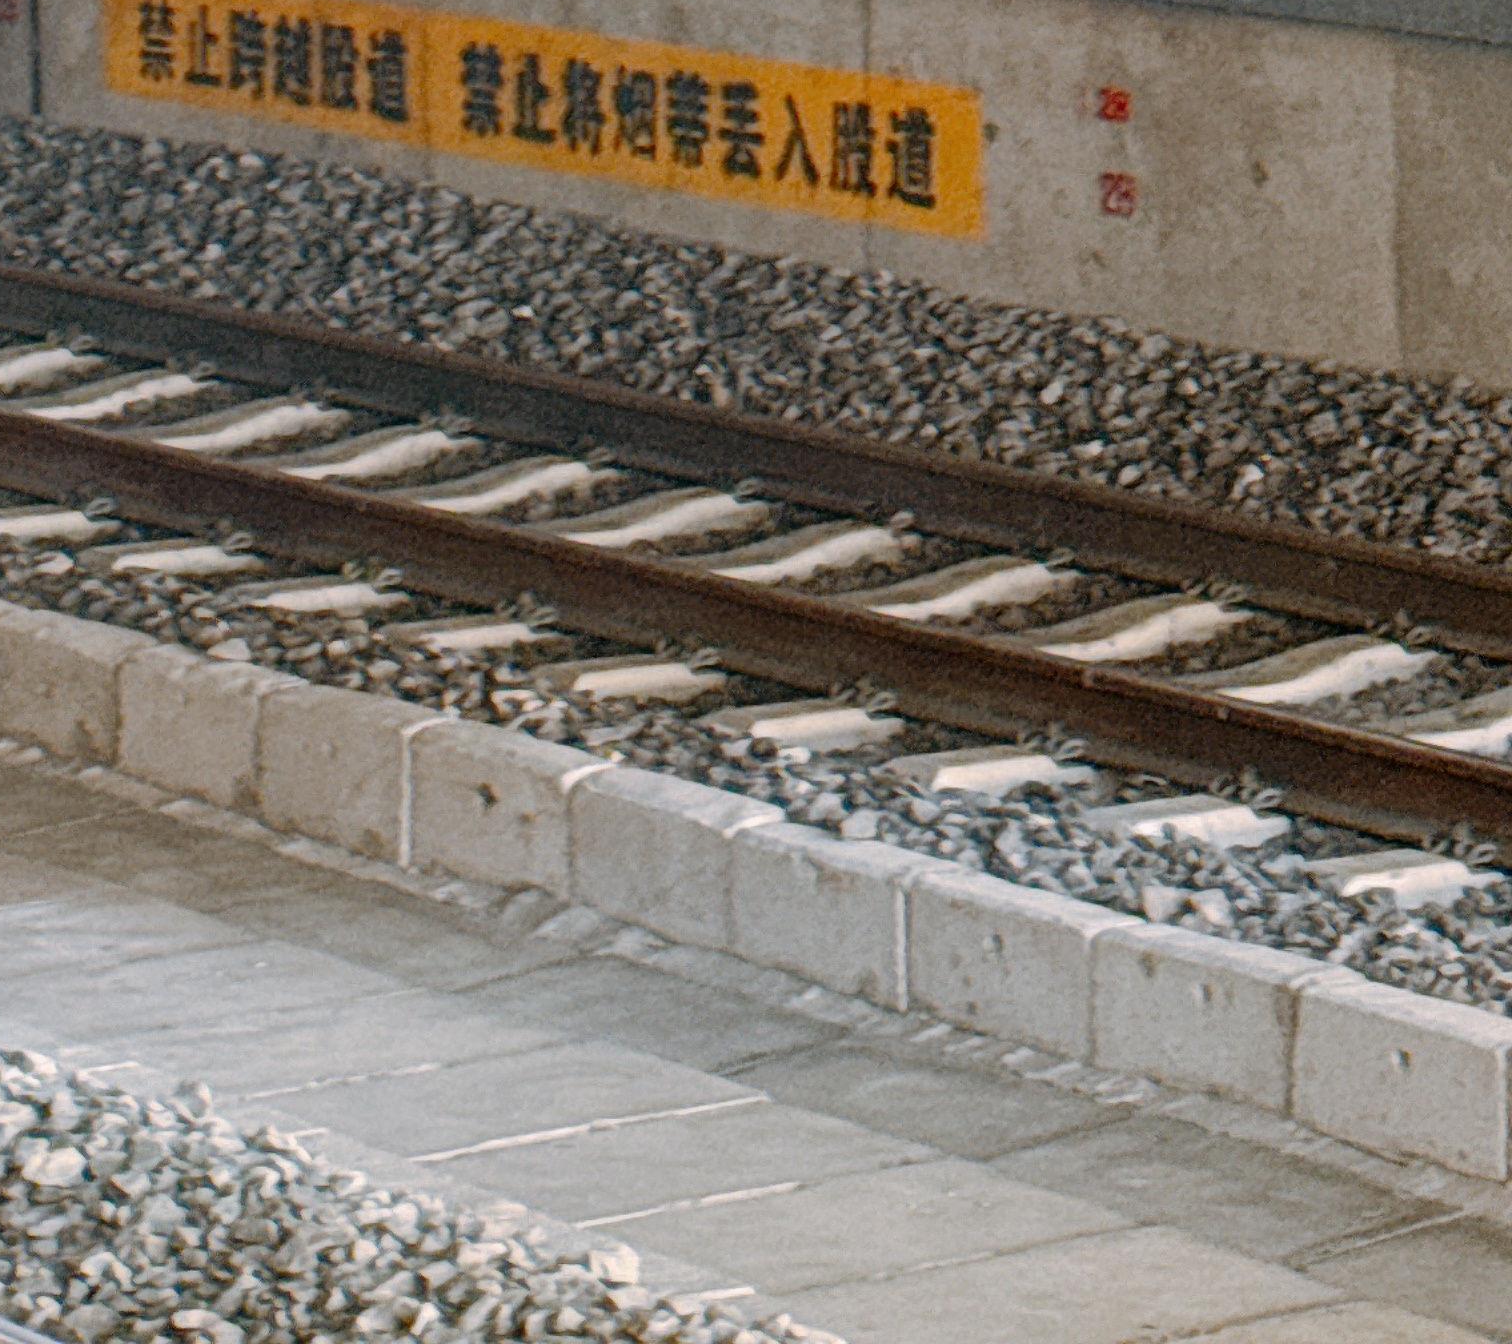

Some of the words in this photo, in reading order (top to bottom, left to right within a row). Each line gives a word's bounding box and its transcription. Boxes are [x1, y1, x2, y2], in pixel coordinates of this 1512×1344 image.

[458, 40, 938, 210] 禁止将烟蒂丢入股道
